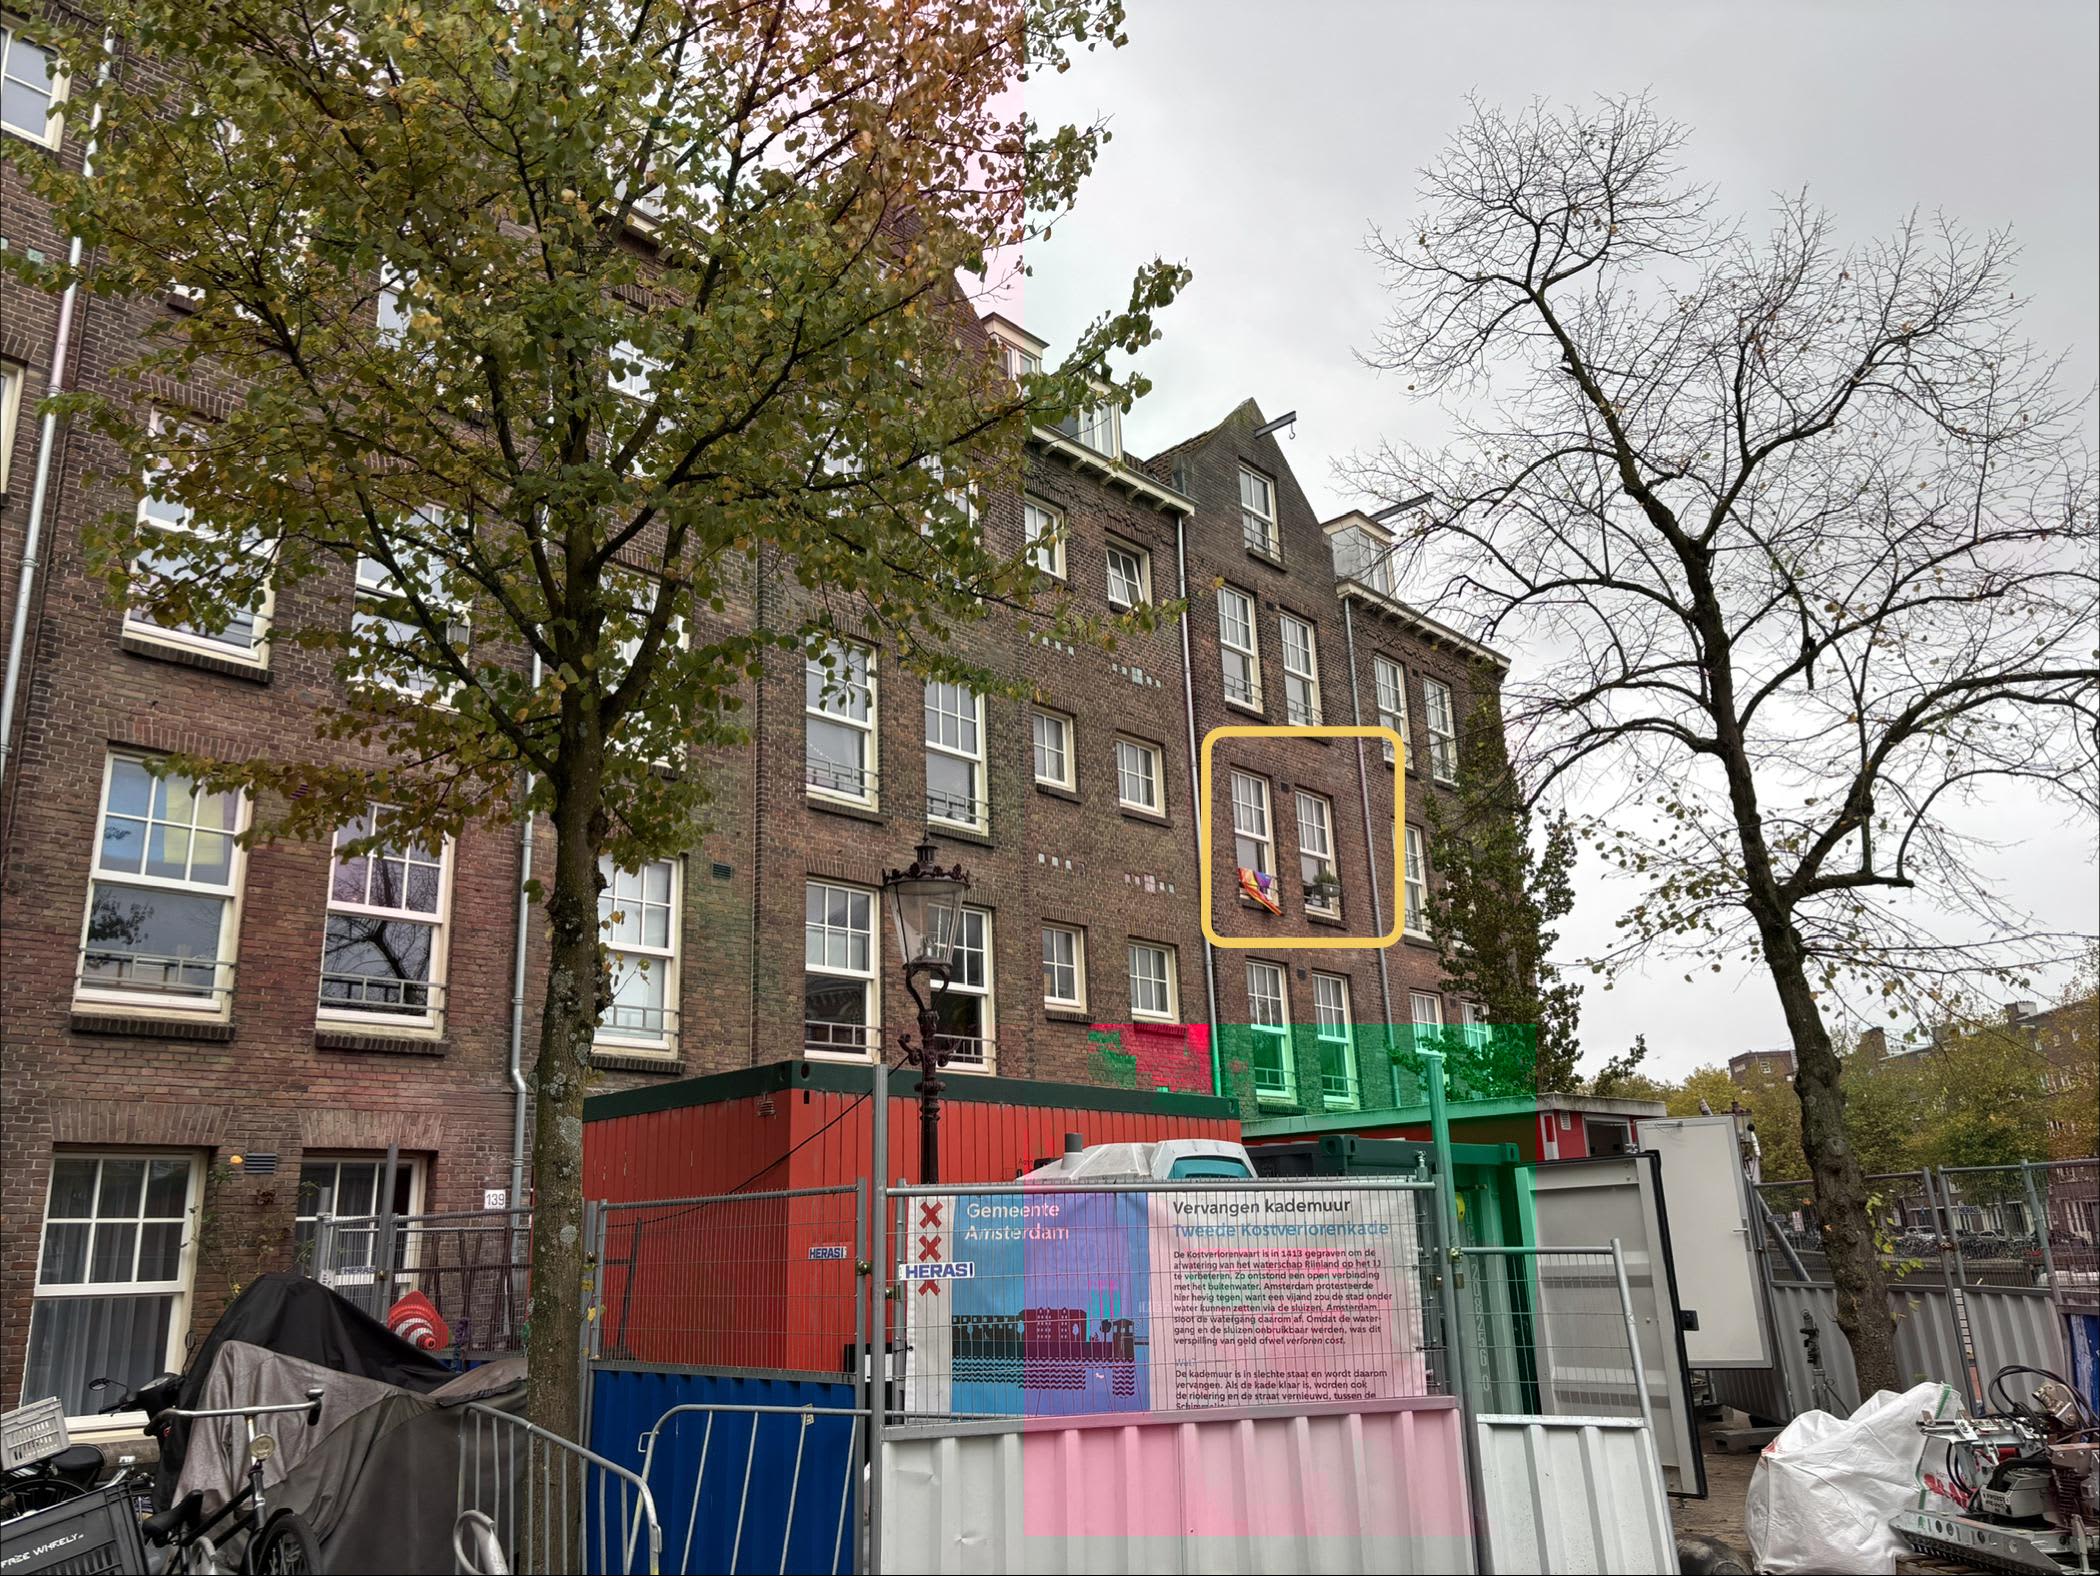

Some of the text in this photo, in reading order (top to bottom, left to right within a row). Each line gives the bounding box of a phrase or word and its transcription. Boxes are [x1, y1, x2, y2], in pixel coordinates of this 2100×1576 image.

[487, 1193, 504, 1206] 139
[967, 1202, 1060, 1218] Gemeente
[1173, 1198, 1350, 1217] Vervangen kademuur
[964, 1222, 1069, 1241] Amsterdam
[1173, 1221, 1389, 1237] Tweede Kostverlorenkade
[1174, 1251, 1185, 1259] De
[1187, 1250, 1260, 1259] Kostverlorenvaart
[1262, 1249, 1269, 1258] is
[1271, 1249, 1279, 1258] in
[1281, 1249, 1302, 1257] 1413
[1305, 1250, 1346, 1258] gegraven
[1364, 1248, 1376, 1256] de
[1174, 1261, 1217, 1271] afwatering
[1236, 1260, 1250, 1269] het
[1253, 1260, 1303, 1270] waterschap
[1342, 1261, 1353, 1270] op
[1355, 1260, 1370, 1268] het
[1234, 1272, 1245, 1280] Zo
[1248, 1271, 1286, 1280] ontstond
[1307, 1272, 1329, 1280] open
[1331, 1270, 1380, 1280] verbinding
[1192, 1282, 1206, 1290] het
[1264, 1282, 1314, 1290] Amsterdam
[1316, 1282, 1374, 1291] protesteerde
[1174, 1293, 1189, 1301] hier
[1191, 1293, 1214, 1302] hevig
[1245, 1293, 1266, 1301] want
[1286, 1292, 1312, 1302] vijand
[1332, 1292, 1343, 1300] de
[1345, 1292, 1364, 1300] stad
[1366, 1292, 1392, 1300] onder
[1200, 1303, 1231, 1311] kunnen
[1263, 1303, 1275, 1311] via
[1277, 1303, 1289, 1311] de
[1326, 1303, 1377, 1311] Amsterdam
[1196, 1315, 1208, 1323] de
[1210, 1316, 1256, 1325] watergang
[1258, 1314, 1292, 1323] daarom
[1306, 1314, 1336, 1323] Omdat
[1339, 1314, 1351, 1322] de
[1174, 1327, 1195, 1335] gang
[1210, 1326, 1221, 1334] de
[1223, 1325, 1253, 1334] sluizen
[1255, 1325, 1308, 1334] onbruikbaar
[1368, 1325, 1381, 1333] dit
[1174, 1336, 1218, 1346] verspilling
[1220, 1337, 1235, 1345] van
[1237, 1336, 1256, 1346] geld
[1259, 1336, 1284, 1345] ofwel
[1286, 1336, 1323, 1345] verloren
[1175, 1370, 1186, 1378] De
[1189, 1370, 1232, 1378] kademuur
[1234, 1370, 1241, 1378] is
[1243, 1370, 1251, 1378] in
[1253, 1370, 1285, 1378] slechte
[1287, 1370, 1309, 1378] staat
[1325, 1370, 1351, 1378] wordt
[1353, 1369, 1388, 1377] daarom
[1225, 1381, 1238, 1389] Als
[1240, 1381, 1252, 1389] de
[1254, 1381, 1276, 1389] kade
[1278, 1381, 1300, 1389] klaar
[1314, 1381, 1348, 1389] worden
[1350, 1380, 1367, 1389] ook
[1176, 1392, 1188, 1400] de
[1189, 1392, 1226, 1402] riolering
[1227, 1392, 1239, 1400] en
[1241, 1392, 1252, 1400] de
[1254, 1392, 1280, 1400] straat
[1364, 1391, 1376, 1399] de
